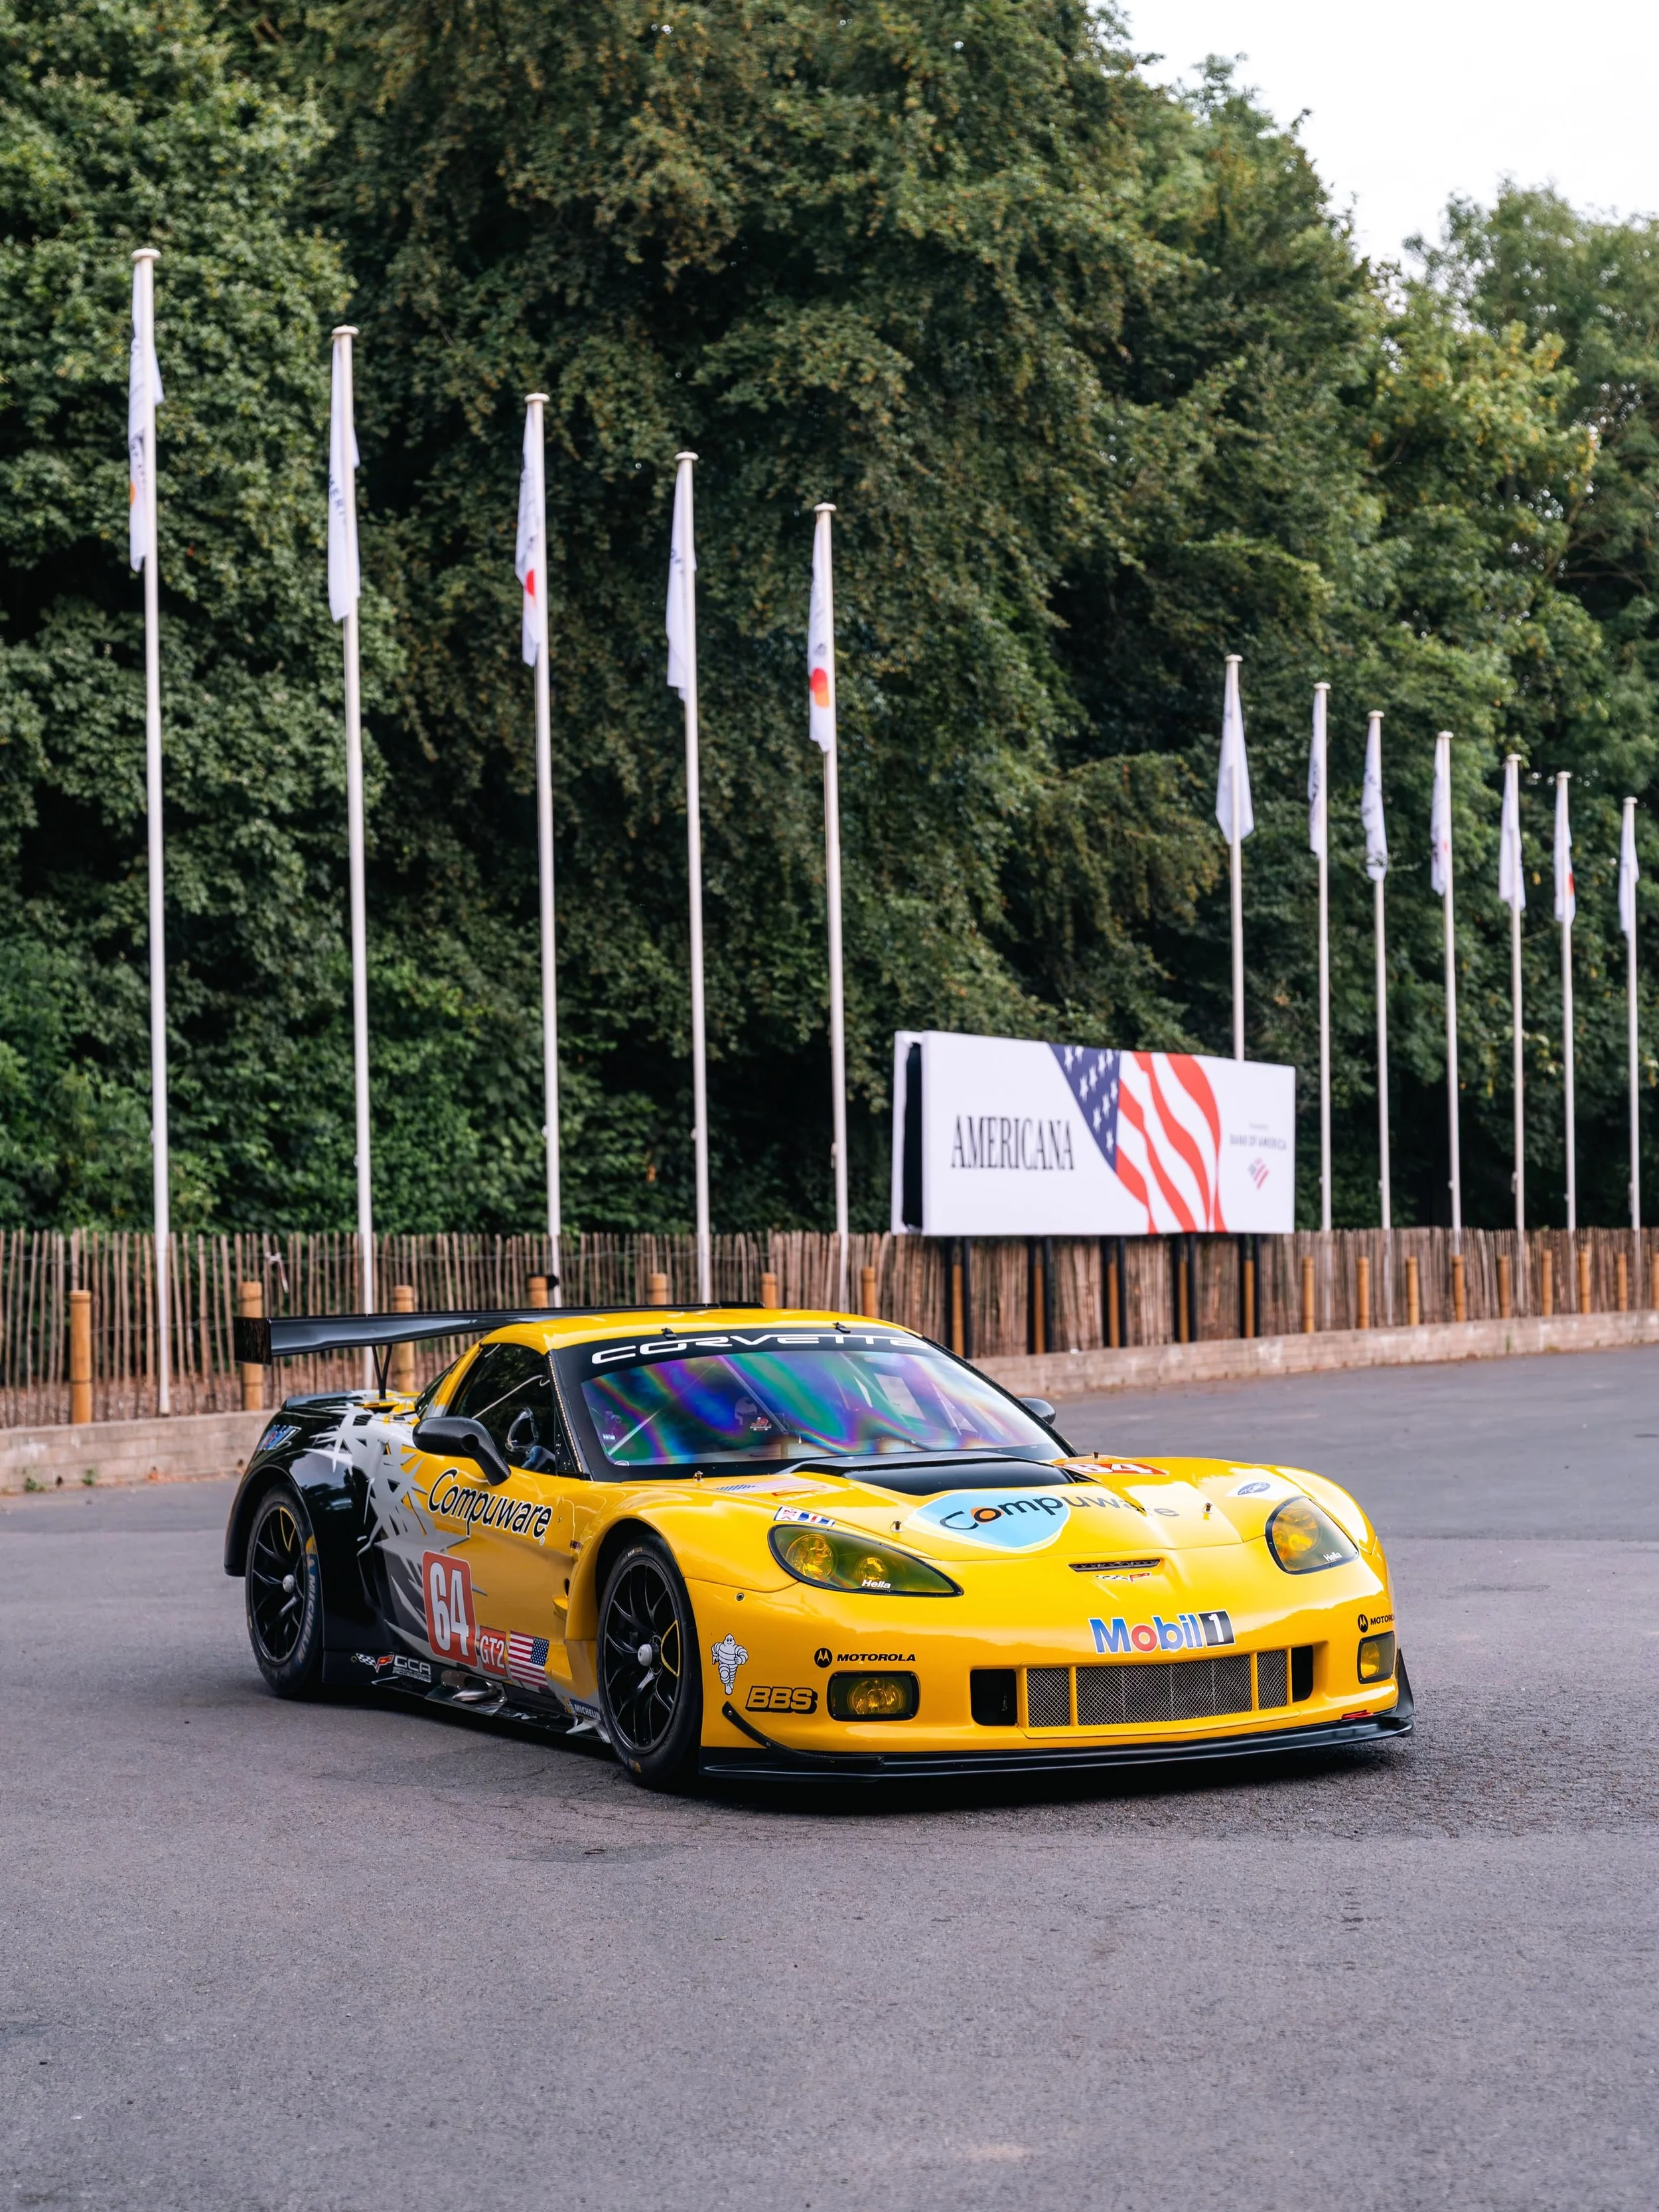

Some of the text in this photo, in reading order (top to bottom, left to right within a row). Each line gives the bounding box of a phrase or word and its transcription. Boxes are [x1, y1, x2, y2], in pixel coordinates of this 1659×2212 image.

[951, 1115, 1074, 1170] AMERICANA
[591, 1333, 930, 1364] CORVETTE
[1063, 1463, 1153, 1474] 64
[428, 1469, 552, 1539] Compuware
[1323, 1552, 1342, 1562] Hella
[861, 1579, 891, 1589] Hella
[297, 1574, 317, 1664] MICHELIN
[430, 1562, 469, 1657] 64
[1089, 1614, 1203, 1653] Mobil
[394, 1655, 431, 1675] GCA
[480, 1635, 505, 1669] GT2
[837, 1653, 916, 1662] MOTOROLA
[745, 1686, 818, 1714] BBS
